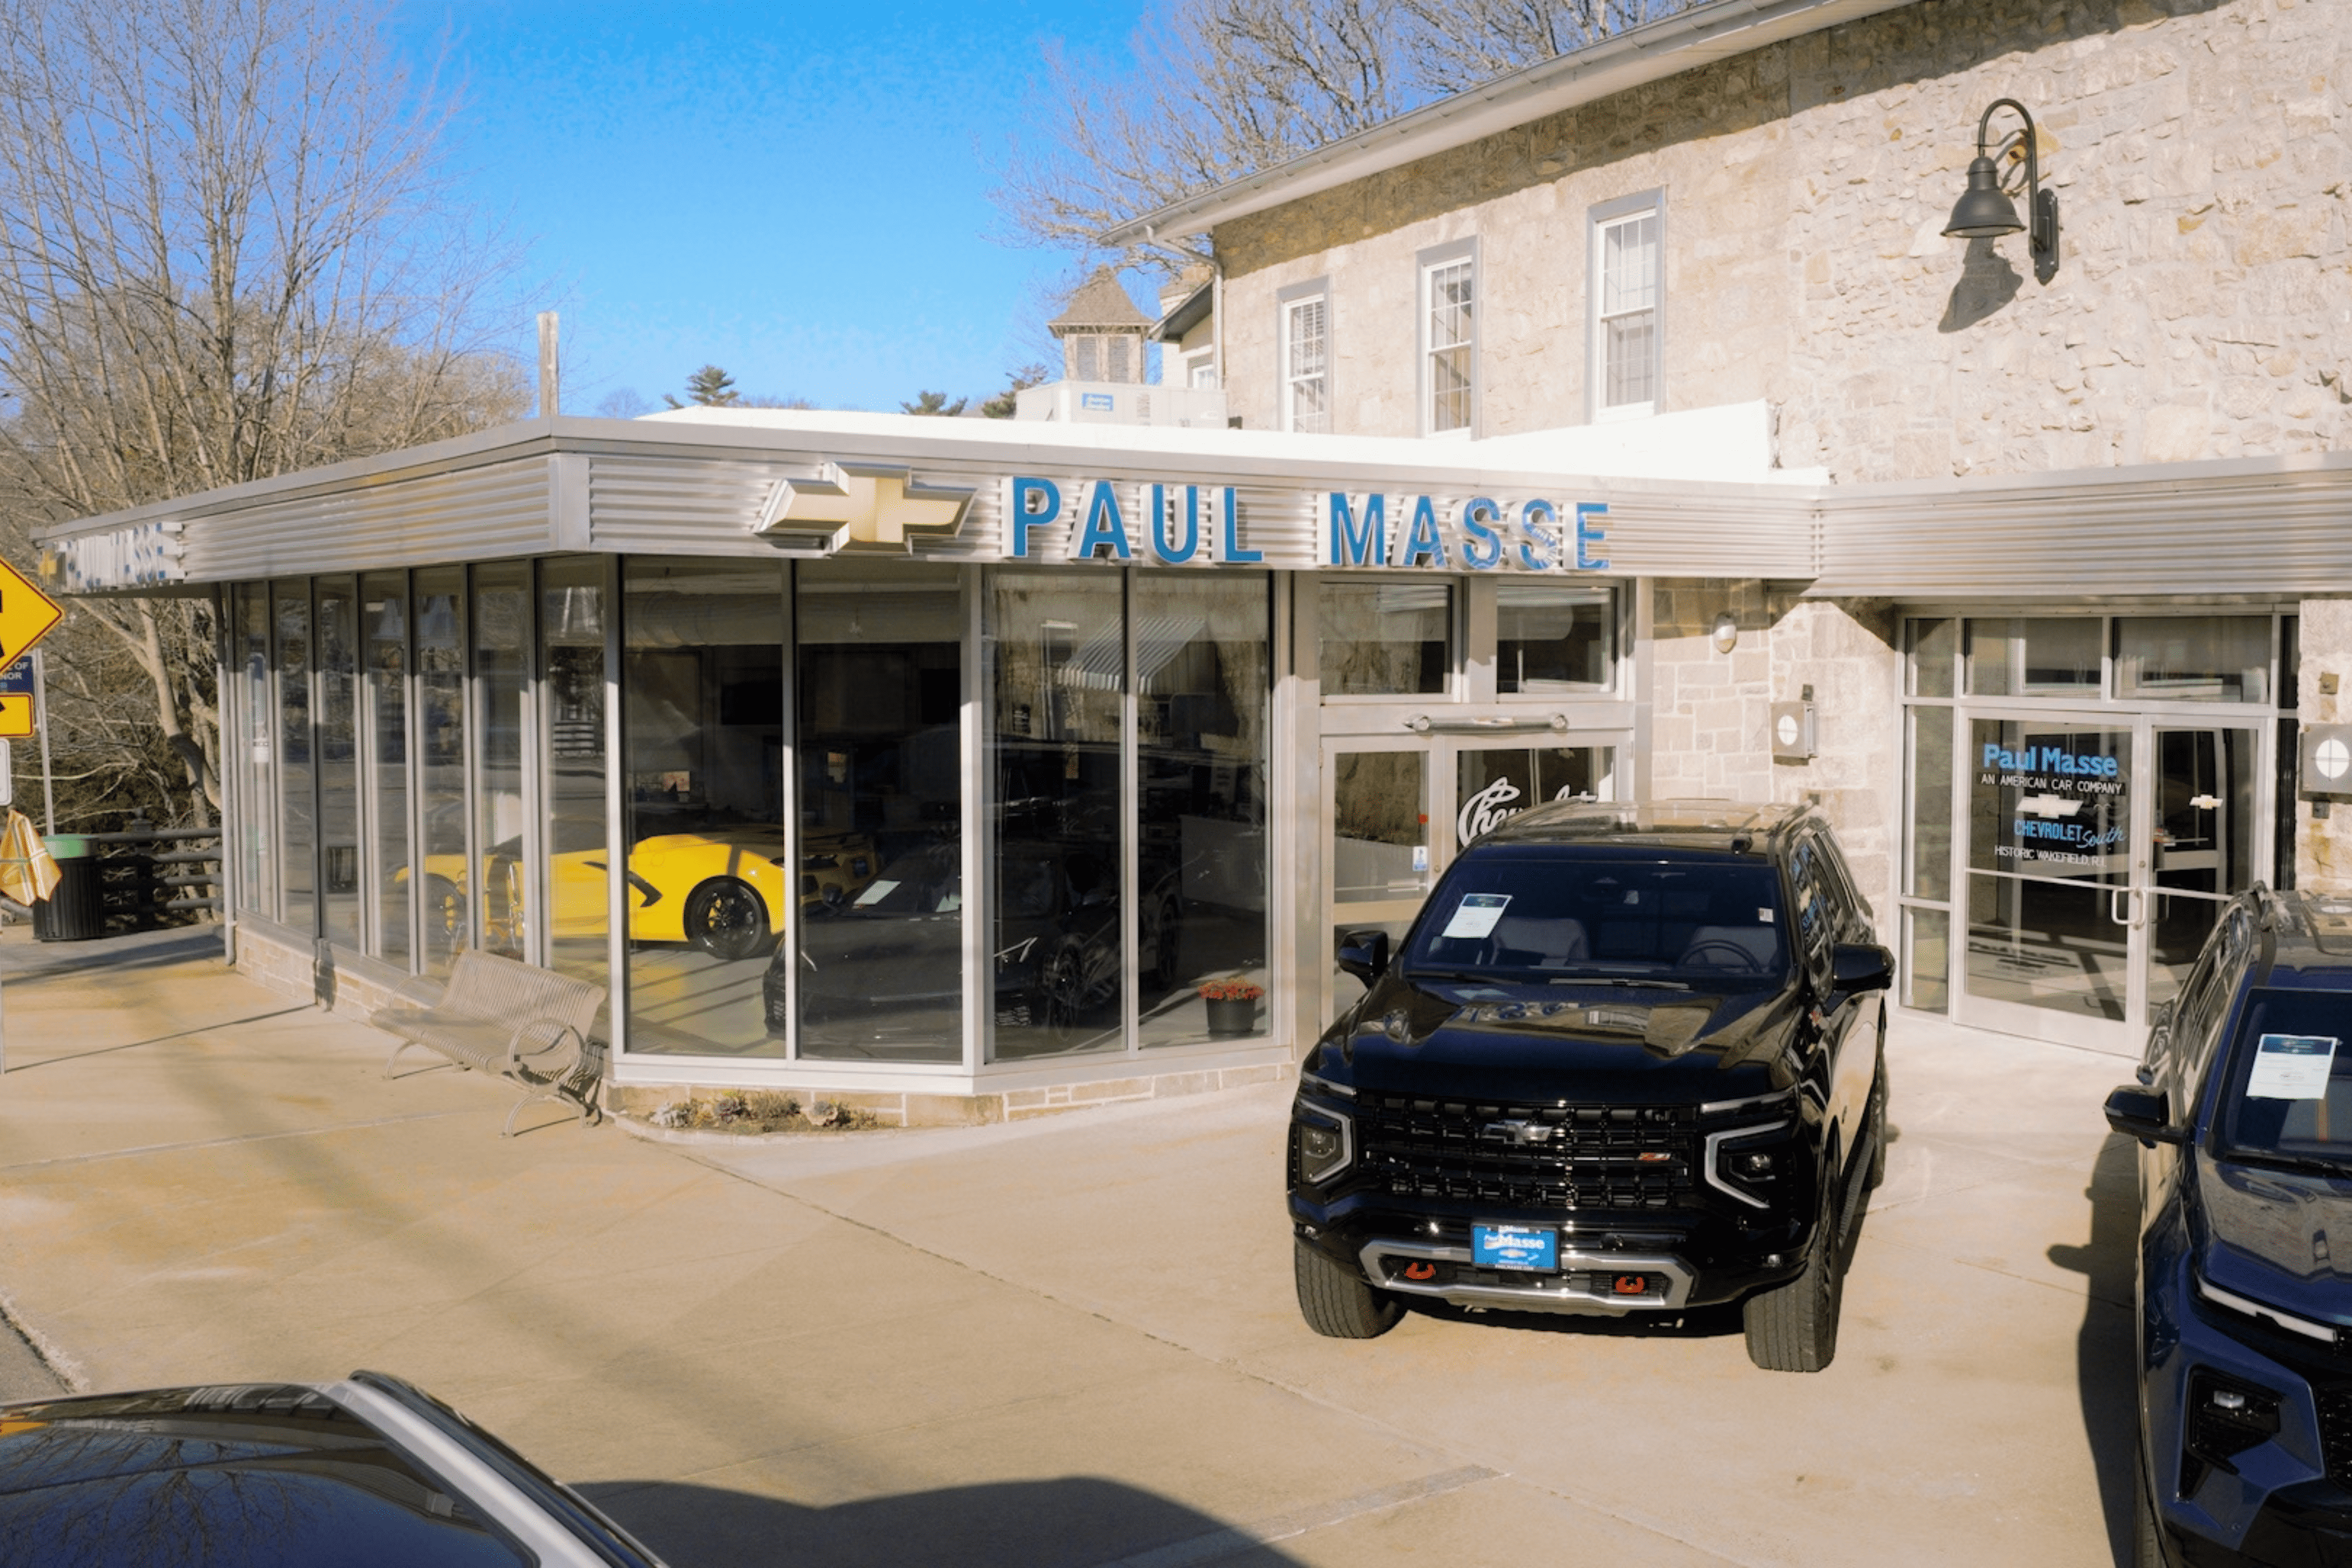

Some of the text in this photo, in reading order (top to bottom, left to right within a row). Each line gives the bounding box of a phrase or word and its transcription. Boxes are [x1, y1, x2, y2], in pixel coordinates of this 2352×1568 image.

[1012, 476, 1610, 570] PAUL MASSE
[1984, 744, 2118, 776] Paul Masse
[1981, 773, 2122, 794] AN AMERICAN CAR COMPANY
[2014, 819, 2127, 849] CHEVROLET South
[1994, 845, 2034, 859] HISTORIC
